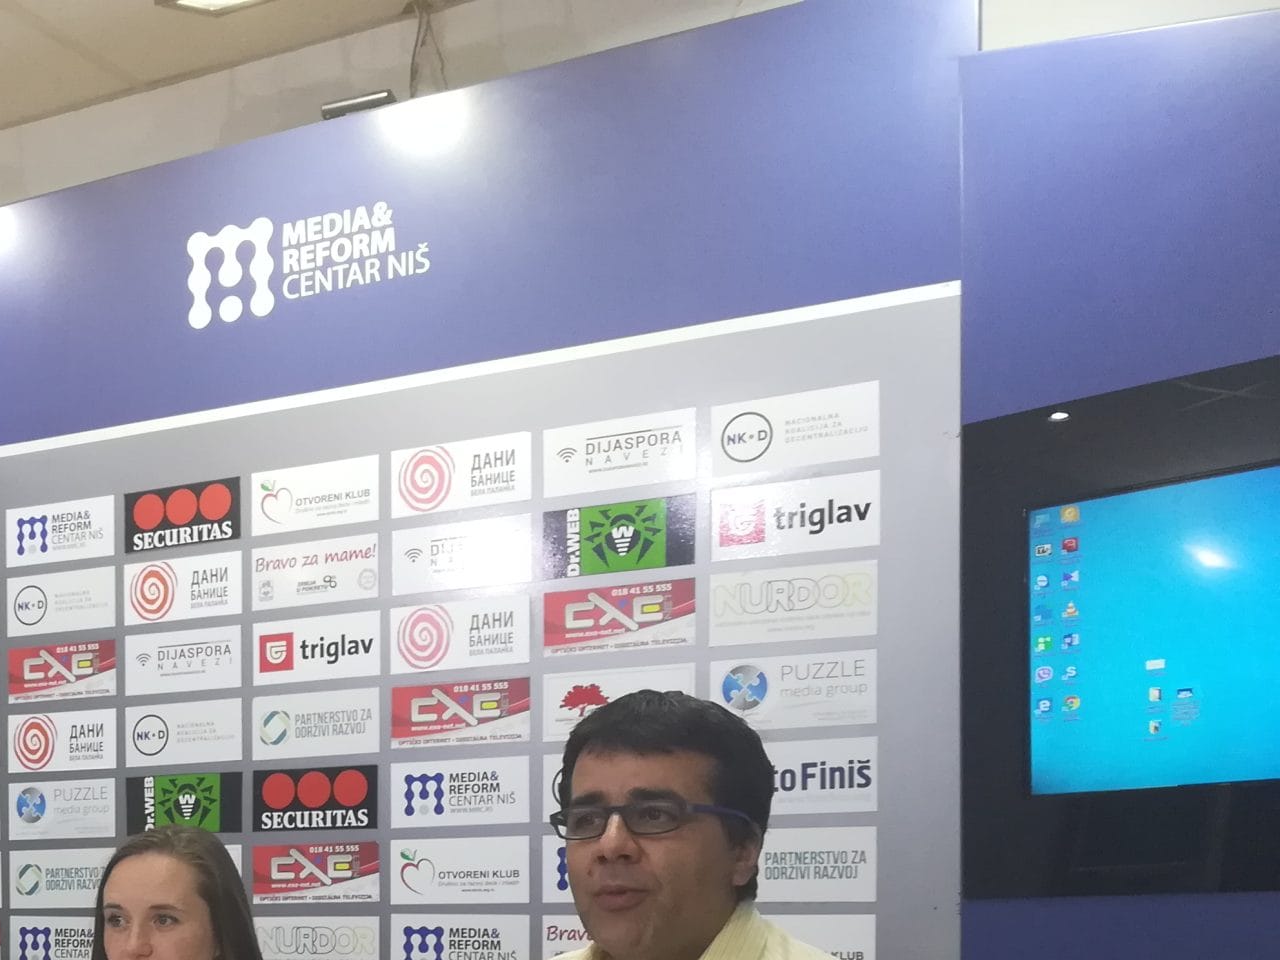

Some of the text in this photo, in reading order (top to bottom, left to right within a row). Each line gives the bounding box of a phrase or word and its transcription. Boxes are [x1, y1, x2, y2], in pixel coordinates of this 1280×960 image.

[282, 201, 393, 248] MEDIA&
[282, 227, 396, 274] REFORM
[282, 241, 431, 300] CENTAR NIŠ
[586, 430, 682, 455] DIJASPORA
[471, 449, 516, 475] ДАНИ
[471, 470, 516, 487] БАНИЦЕ
[295, 489, 371, 507] OTVORENI KLUB
[51, 510, 91, 523] MEDIA&
[773, 499, 872, 535] triglav
[51, 521, 92, 533] REFORM
[51, 532, 86, 545] CENTAR
[133, 521, 232, 551] SECURITAS
[255, 543, 376, 573] Bravo za mame!
[191, 567, 228, 588] ДАНИ
[191, 586, 228, 601] БАНИЦЕ
[469, 611, 514, 634] ДАНИ
[469, 632, 514, 647] БАНИЦЕ
[158, 644, 231, 661] DIJASPORA
[300, 634, 374, 664] triglav
[781, 659, 865, 681] PUZZLE
[780, 682, 868, 698] media group
[295, 709, 373, 727] PARTNERSTVO ZA
[70, 723, 104, 740] ДАНИ
[295, 722, 366, 739] ODRŽIVI RAZVOJ
[69, 742, 104, 754] БАНИЦЕ
[449, 771, 499, 783] MEDIA&
[53, 786, 108, 801] PUZZLE
[449, 783, 500, 795] REFORM
[449, 794, 494, 807] CENTAR
[53, 804, 110, 816] media group
[261, 809, 369, 830] SECURITAS
[765, 850, 867, 866] PARTNERSTVO ZA
[45, 867, 99, 879] PARTNERSTVO
[438, 869, 520, 880] OTVORENI KLUB
[765, 863, 858, 880] ODRŽIVI RAZVOJ
[45, 877, 75, 891] ODRŽIVI
[55, 928, 94, 938] MEDIA&
[449, 928, 500, 939] MEDIA&
[55, 938, 94, 949] REFORM
[449, 939, 501, 951] REFORM
[54, 949, 89, 959] CENTAR
